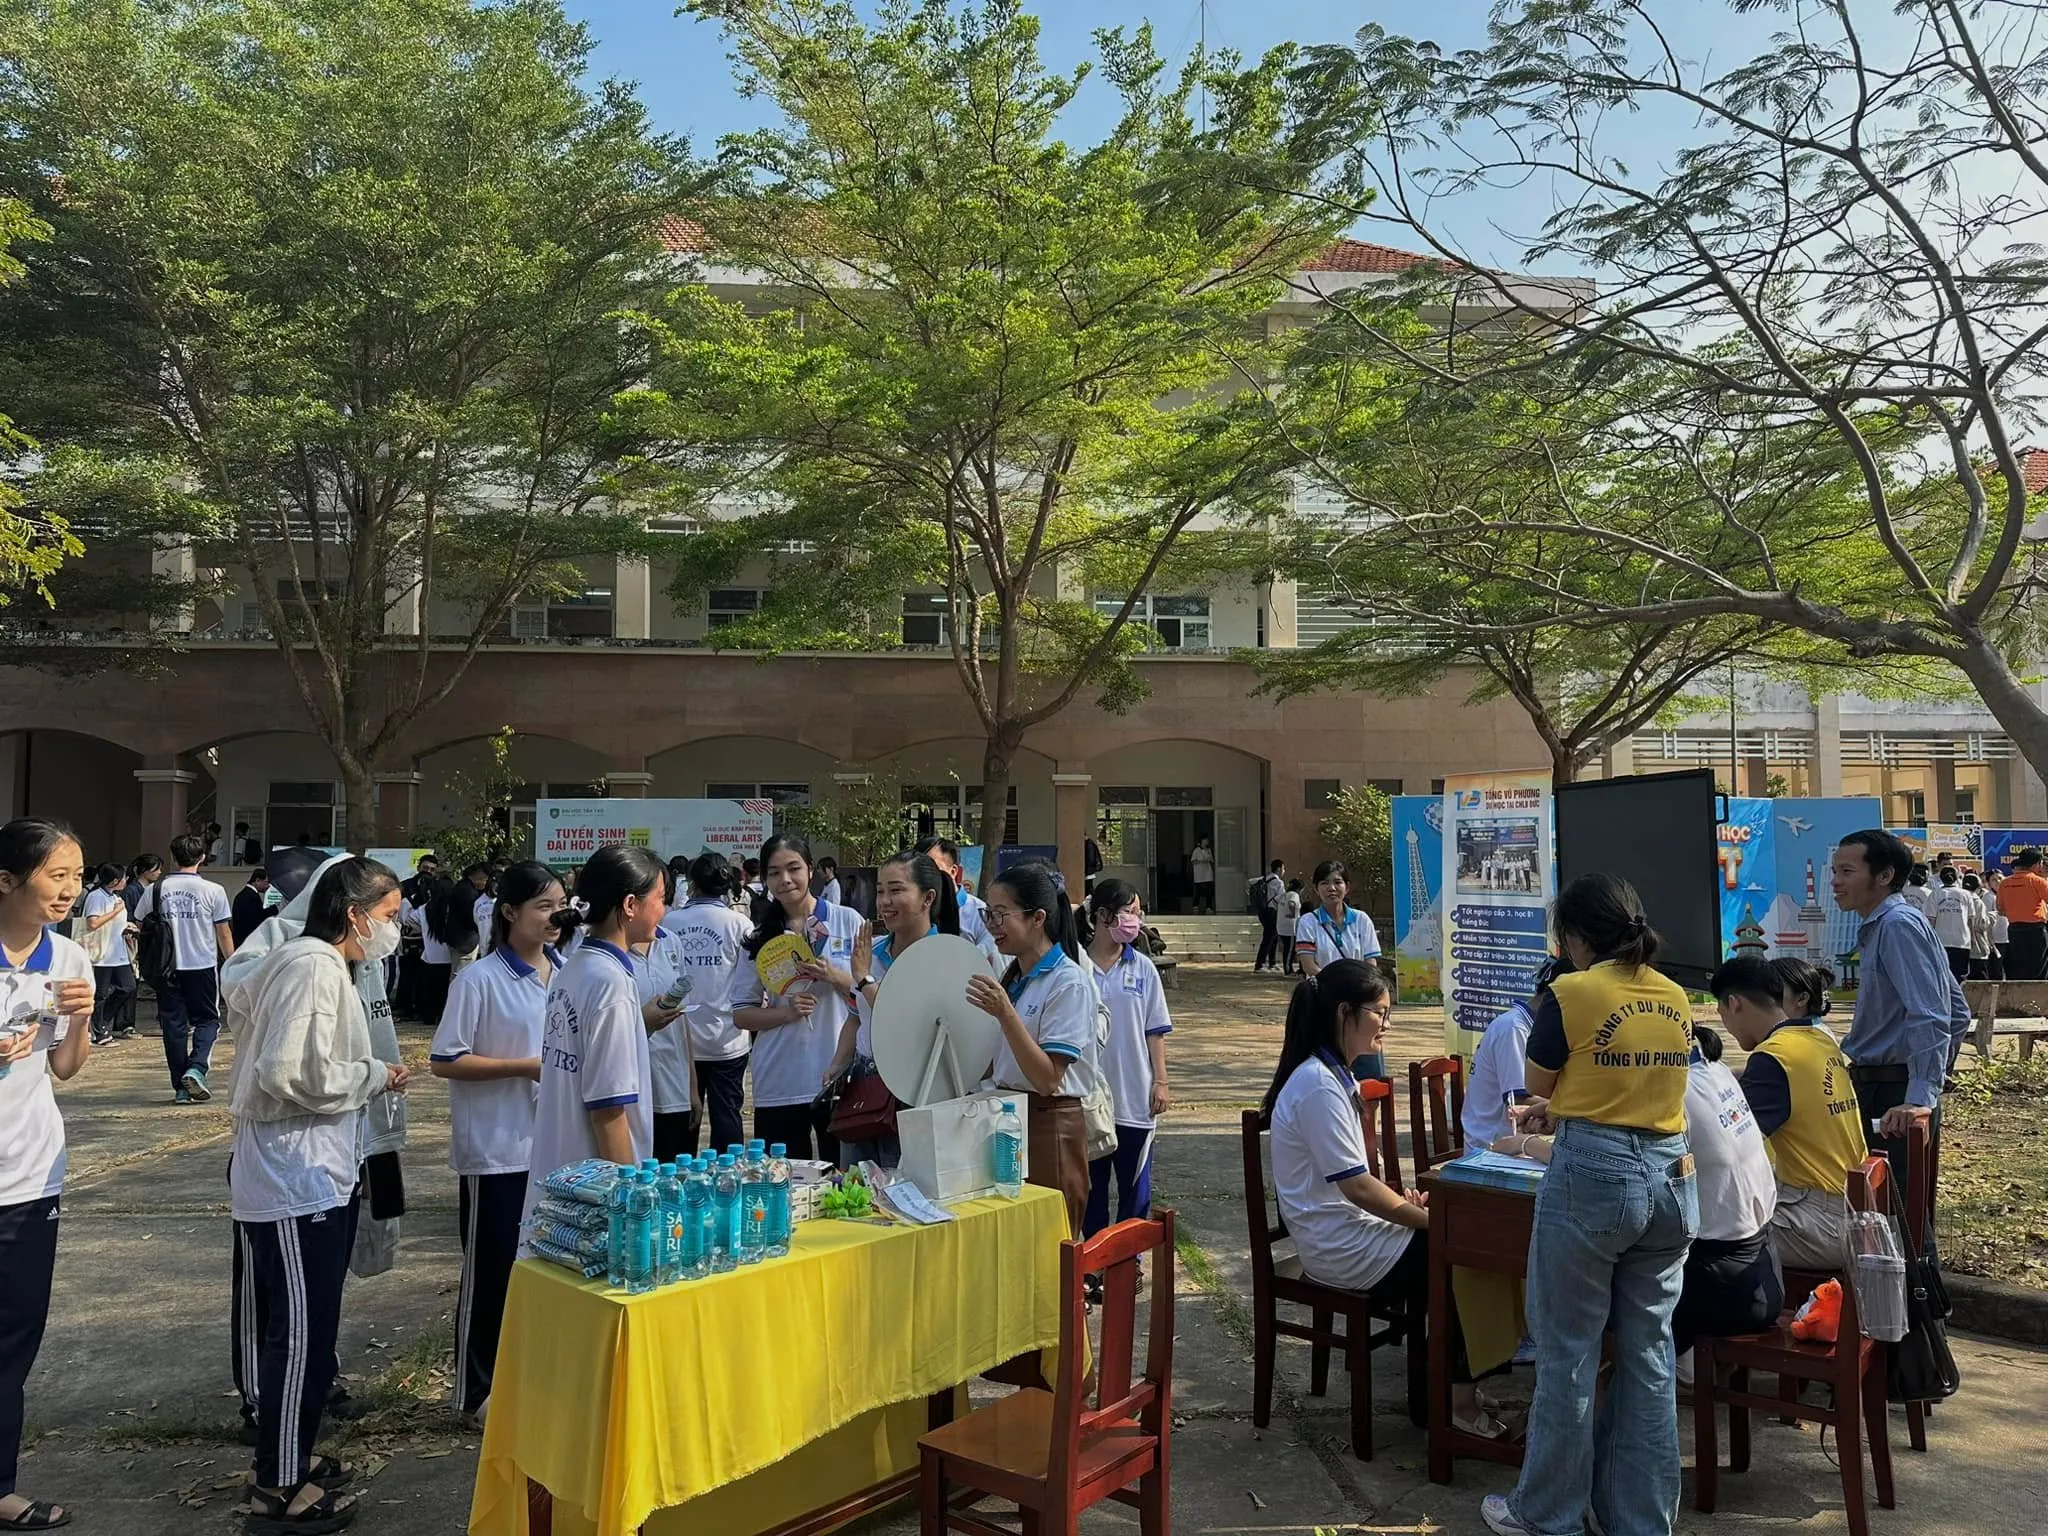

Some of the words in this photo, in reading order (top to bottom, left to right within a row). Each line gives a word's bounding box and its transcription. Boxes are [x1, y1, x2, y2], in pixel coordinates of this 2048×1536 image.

[555, 824, 593, 839] TUYỂN
[598, 828, 626, 839] SINH
[706, 834, 739, 843] LIBERAL
[742, 834, 762, 843] ARTS
[1721, 825, 1751, 844] HỌC
[547, 840, 566, 853] ĐẠI
[570, 840, 594, 853] HỌC
[696, 955, 722, 966] TRE
[1595, 1012, 1622, 1047] CÔNG
[1620, 1004, 1635, 1018] TY
[1637, 1000, 1653, 1013] DU
[1657, 1001, 1681, 1022] HỌC
[1634, 1049, 1650, 1067] VŨ
[1654, 1050, 1690, 1067] PHƯƠN
[666, 1211, 683, 1225] SA
[666, 1238, 681, 1252] RI
